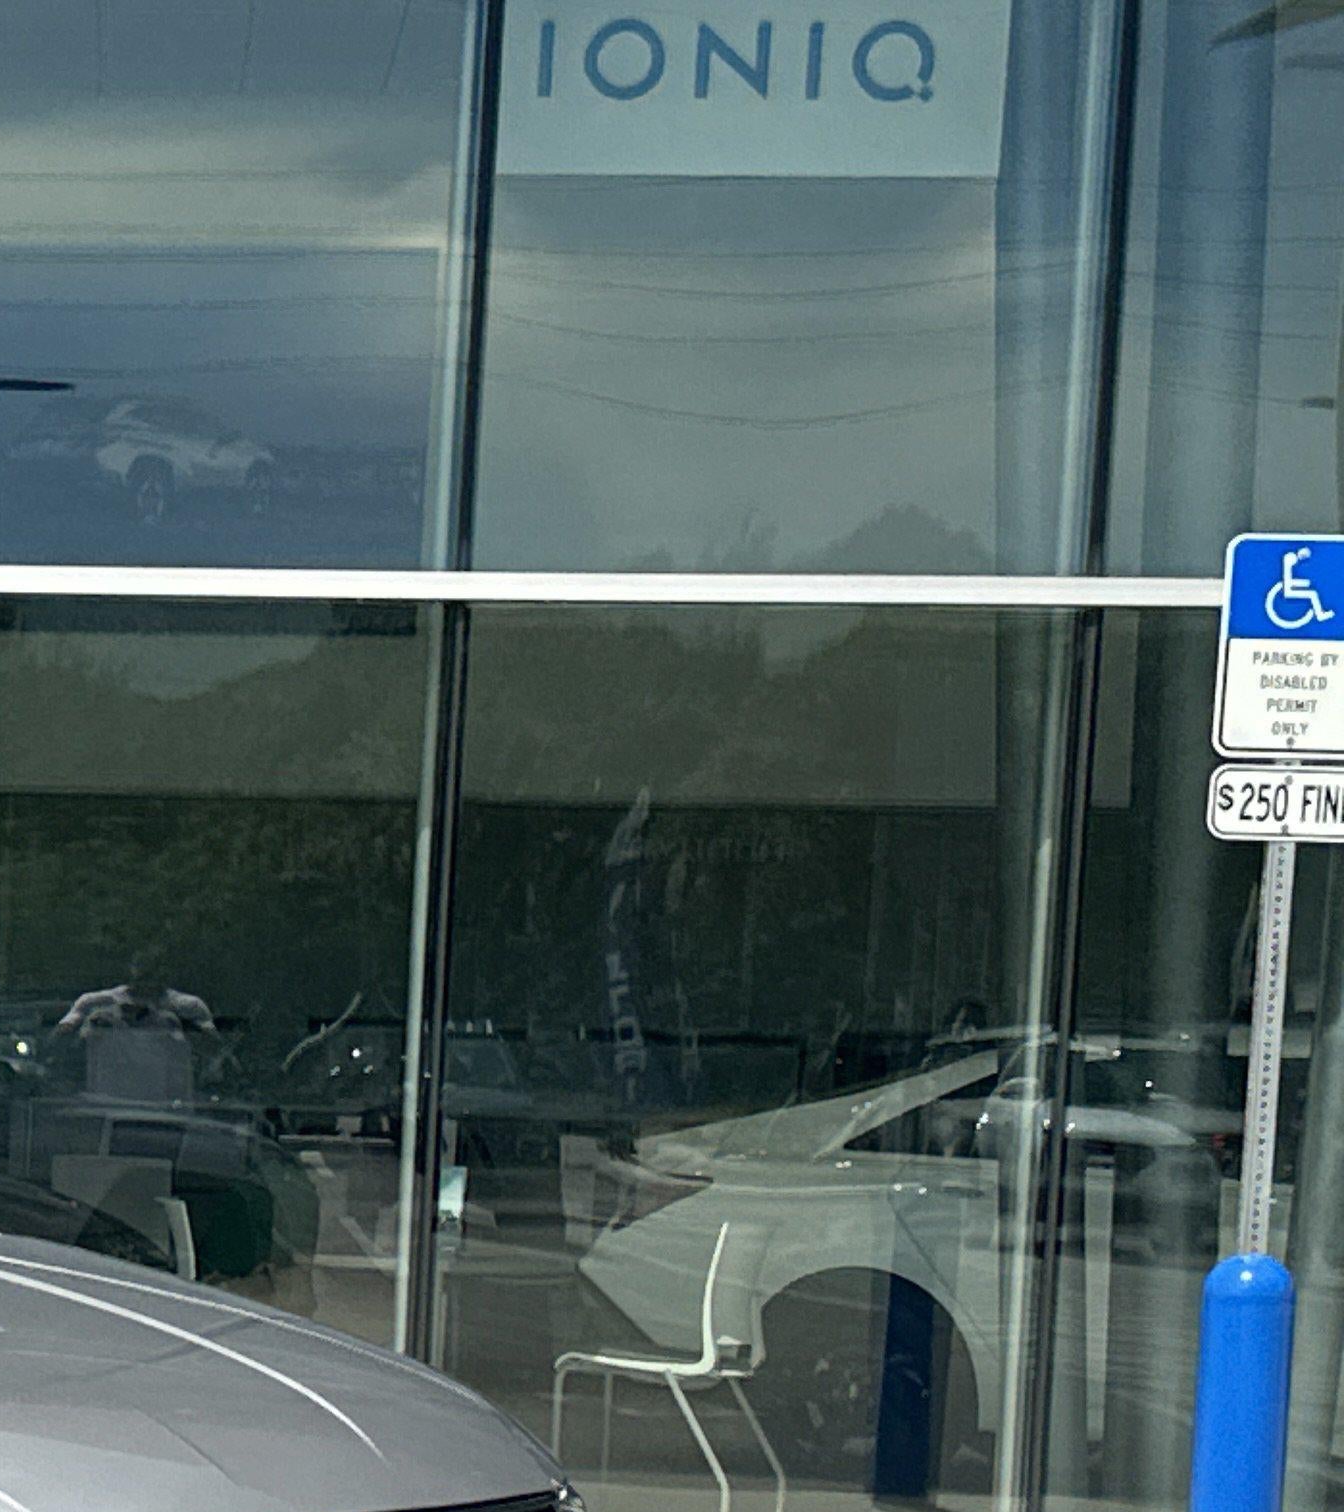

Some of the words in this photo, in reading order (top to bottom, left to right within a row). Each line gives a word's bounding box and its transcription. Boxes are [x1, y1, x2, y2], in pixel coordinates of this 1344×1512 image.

[537, 18, 936, 102] IONIQ
[1252, 651, 1314, 667] PARKING
[1320, 653, 1340, 668] BY
[1259, 674, 1328, 690] DISABLED
[1266, 697, 1318, 713] PERMIT
[1270, 720, 1310, 736] ONLY
